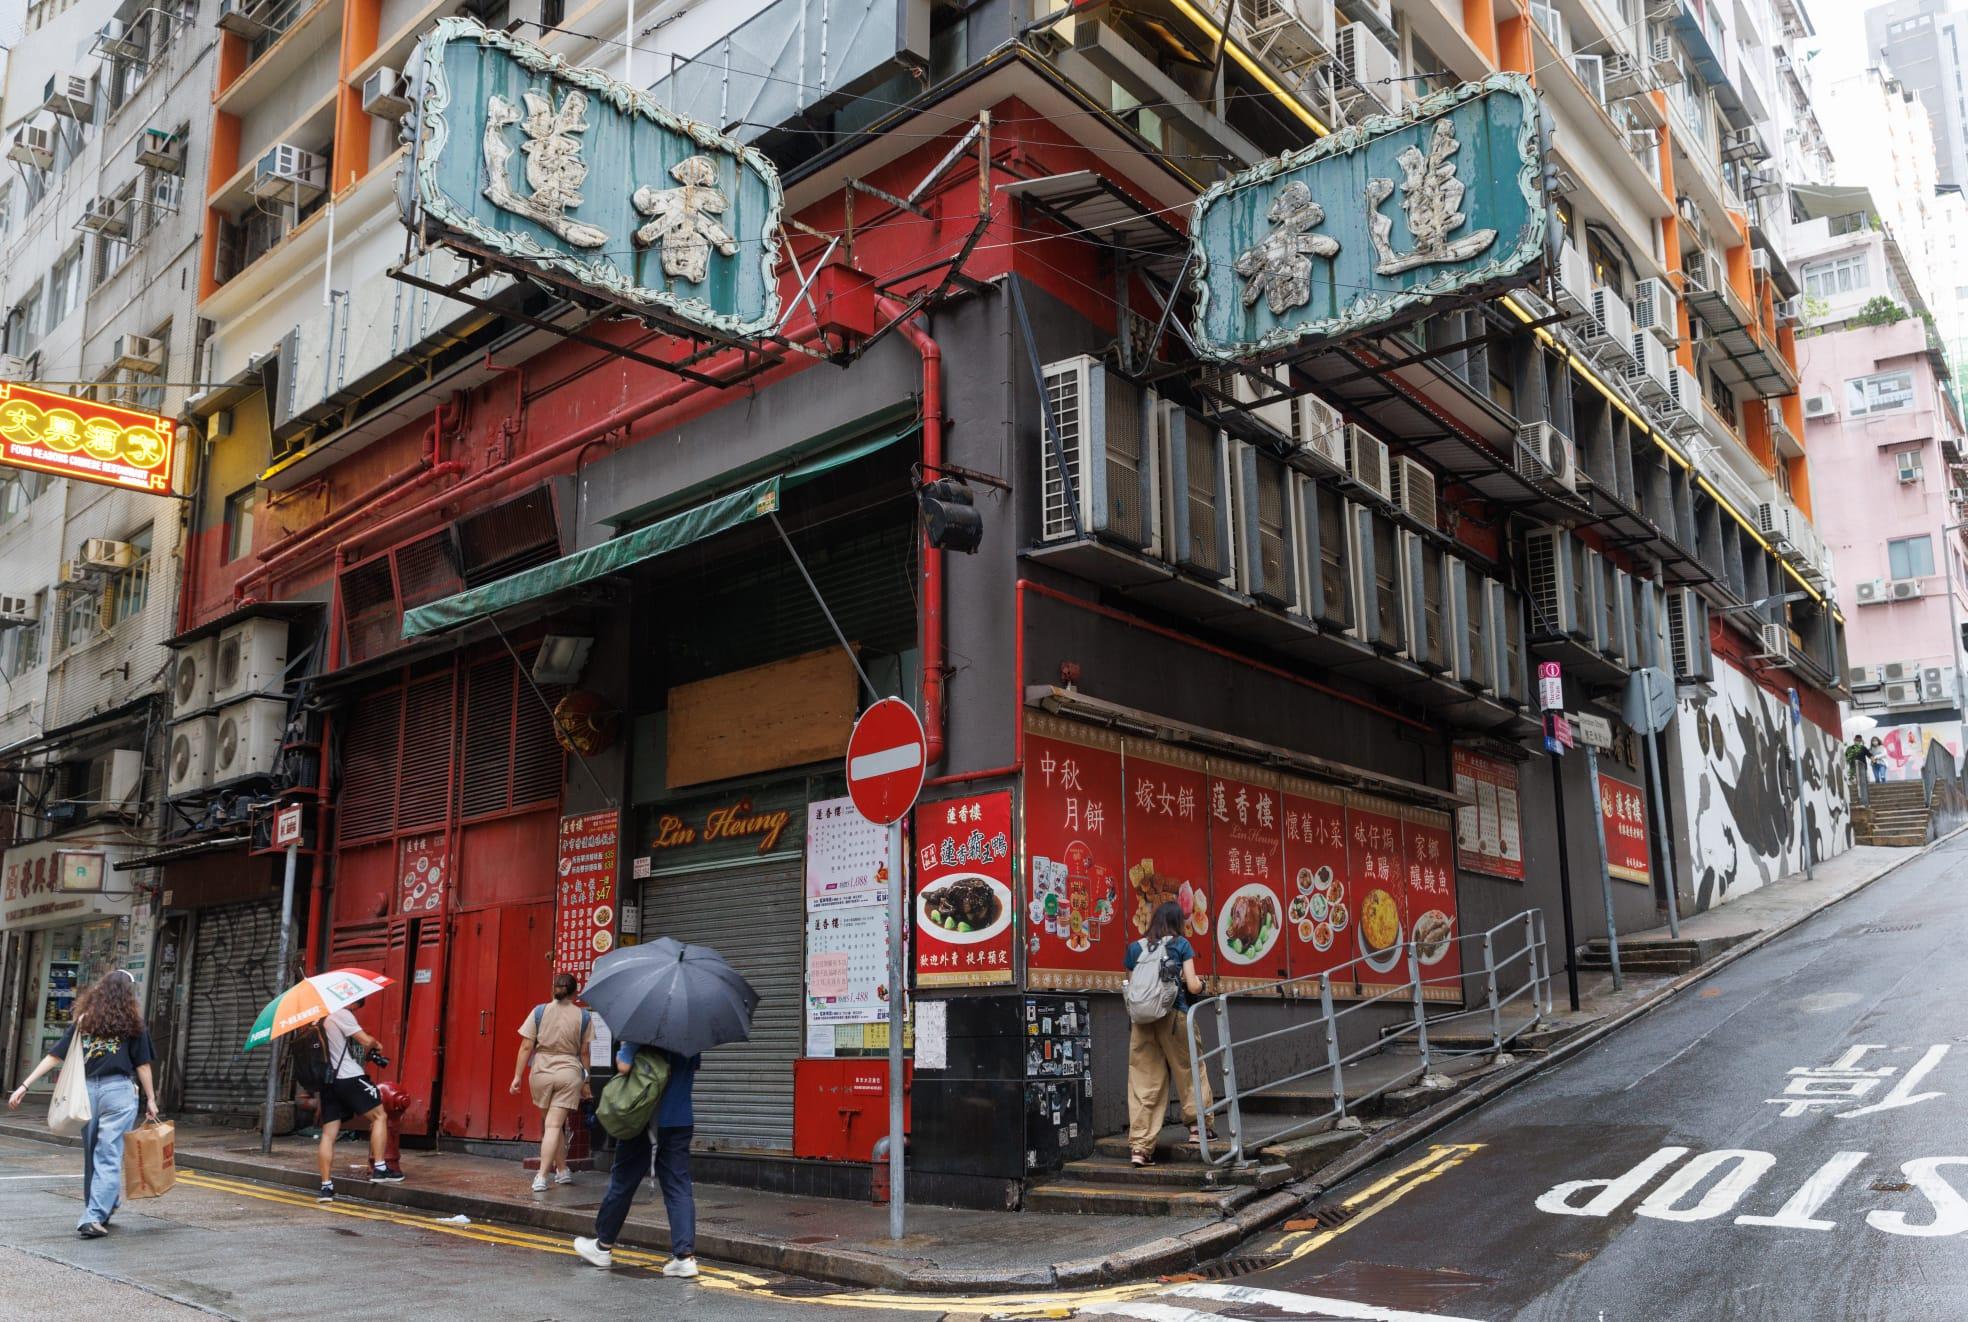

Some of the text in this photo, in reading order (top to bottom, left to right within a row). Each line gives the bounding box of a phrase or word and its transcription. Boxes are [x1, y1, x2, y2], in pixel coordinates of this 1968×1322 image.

[483, 87, 740, 284] 蓮香
[0, 408, 160, 462] 文興酒家
[10, 444, 33, 457] FOUR
[1041, 751, 1082, 791] 中秋
[815, 806, 841, 819] 蓮香樓
[946, 802, 982, 824] 蓮香樓
[1064, 797, 1104, 836] 月餅
[1136, 778, 1196, 822] 嫁女餅
[1212, 781, 1273, 830] 蓮香樓
[1616, 789, 1643, 825] 蓮香樓
[651, 815, 697, 849] Lin
[703, 803, 790, 854] Heung
[1230, 824, 1280, 856] Lin Heung
[1286, 810, 1343, 849] 懷舊小菜
[1354, 820, 1394, 853] 砵仔焗
[940, 829, 1008, 867] 蓮香霸王鴨
[1229, 848, 1269, 879] 霸皇鴨
[1415, 833, 1440, 864] 家鄉
[1364, 852, 1390, 881] 魚腸
[1410, 863, 1449, 895] 釀鯪魚
[596, 886, 612, 901] $47
[815, 917, 840, 931] 蓮香樓
[919, 949, 1009, 968] 歡迎外賣 提早預定
[1764, 1044, 1951, 1118] 停
[1534, 1146, 1968, 1237] STOP
